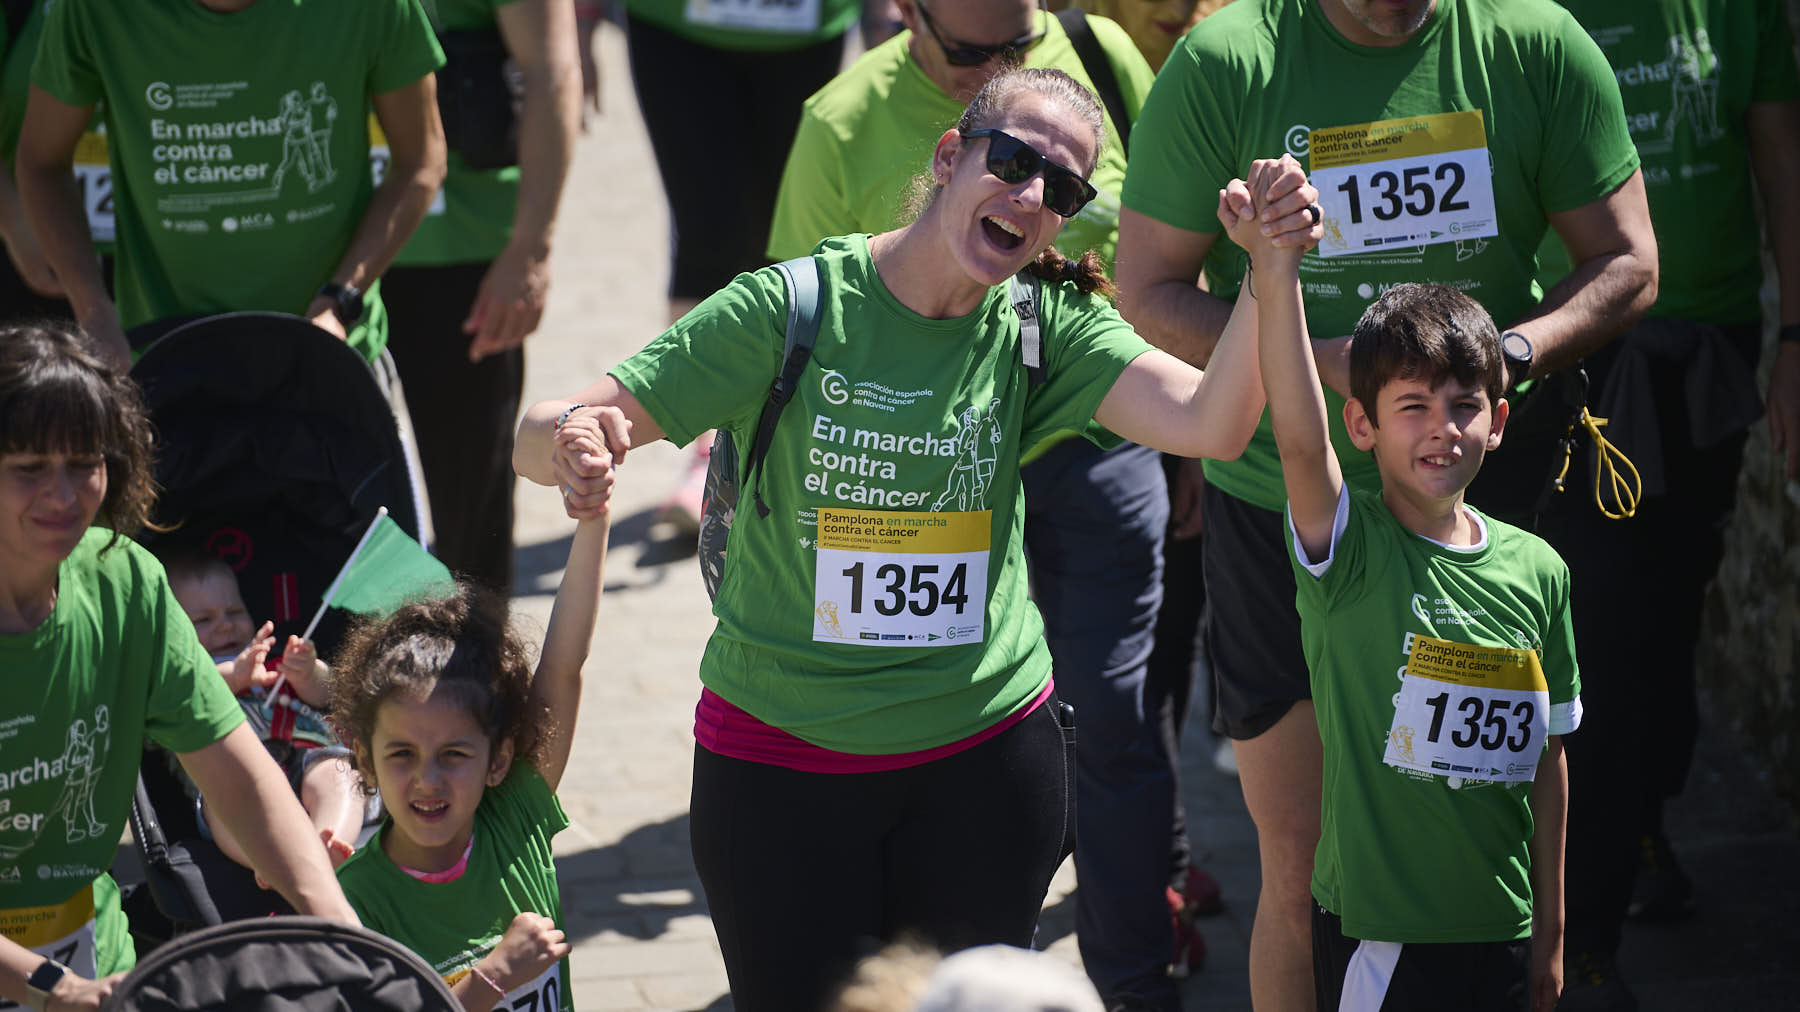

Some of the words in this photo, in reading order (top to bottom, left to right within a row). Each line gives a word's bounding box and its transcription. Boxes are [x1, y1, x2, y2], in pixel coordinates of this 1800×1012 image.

[151, 118, 181, 139] En
[187, 115, 281, 139] marcha
[1313, 129, 1368, 145] Pamplona
[1370, 127, 1385, 137] en
[1387, 121, 1430, 136] marcha
[153, 141, 232, 161] contra
[1313, 140, 1350, 154] contra
[1352, 138, 1363, 149] el
[154, 162, 179, 184] el
[184, 161, 269, 184] cáncer
[1338, 162, 1470, 224] 1352
[855, 388, 878, 399] contra
[879, 392, 886, 401] el
[895, 388, 934, 399] española
[852, 398, 863, 406] en
[863, 399, 895, 412] Navarra
[812, 414, 847, 444] En
[853, 429, 956, 457] marcha
[809, 447, 896, 479] contra
[804, 471, 829, 496] el
[834, 480, 931, 507] cáncer
[824, 512, 883, 526] Pamplona
[886, 517, 900, 526] en
[904, 517, 947, 527] marcha
[823, 524, 862, 535] contra
[864, 526, 875, 536] el
[878, 527, 919, 537] cáncer
[842, 562, 968, 617] 1354
[1418, 640, 1475, 659] Pamplona
[1476, 651, 1489, 661] en
[1415, 652, 1453, 667] contra
[1456, 658, 1466, 669] el
[1468, 660, 1502, 673] cáncer
[1425, 692, 1535, 752] 1353
[0, 812, 44, 832] cer
